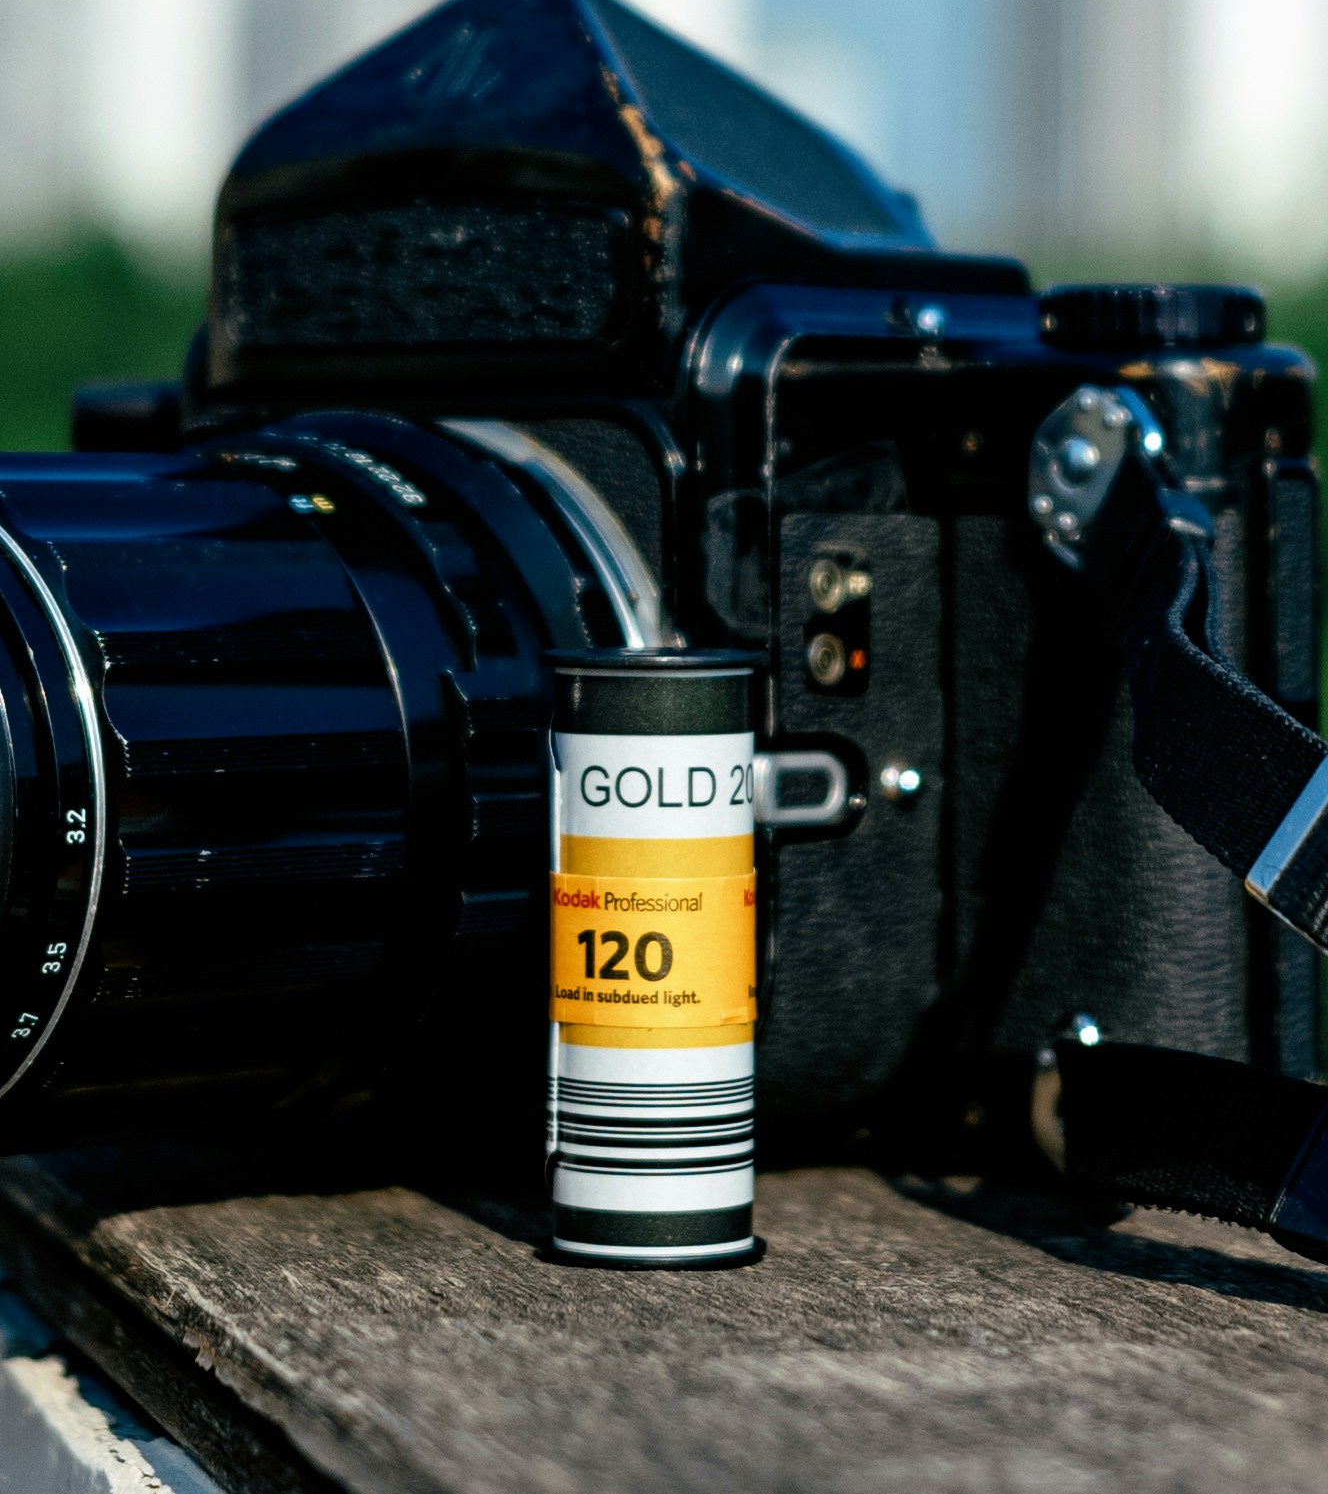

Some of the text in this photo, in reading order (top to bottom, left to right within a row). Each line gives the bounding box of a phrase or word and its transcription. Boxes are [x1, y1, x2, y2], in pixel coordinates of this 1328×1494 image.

[580, 764, 717, 808] GOLD
[66, 807, 87, 844] 3.2
[553, 888, 703, 912] Kodak Professional
[42, 941, 68, 975] 3.5
[577, 929, 674, 981] 120
[555, 984, 701, 1008] Load in subdued light.
[11, 1012, 40, 1040] 3.7
